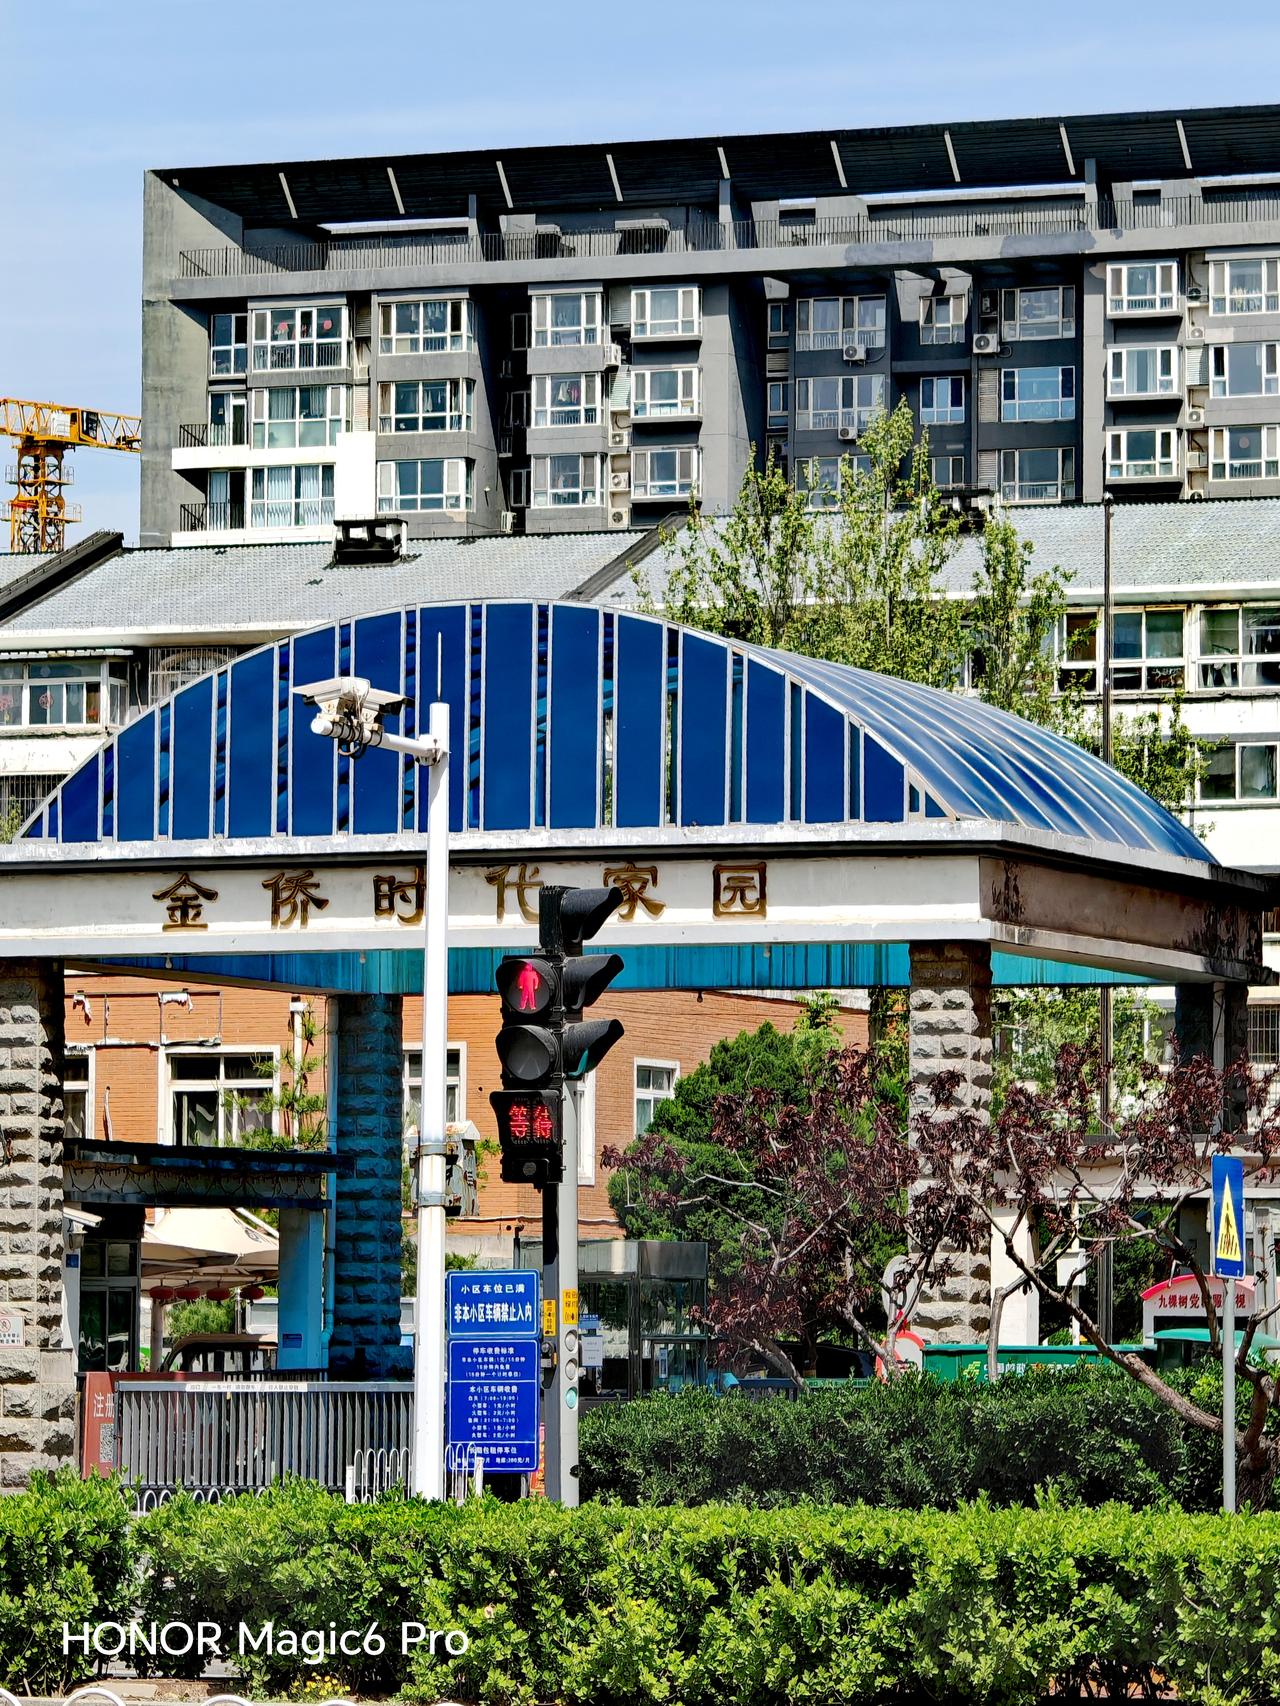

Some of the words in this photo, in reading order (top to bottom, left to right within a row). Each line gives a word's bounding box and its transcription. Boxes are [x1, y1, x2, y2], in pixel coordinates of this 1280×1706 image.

[152, 862, 768, 932] 金侨时代家园
[509, 1104, 552, 1138] 等待
[461, 1284, 525, 1294] 小区车位已满
[454, 1302, 532, 1323] 非本小区车辆禁止入内
